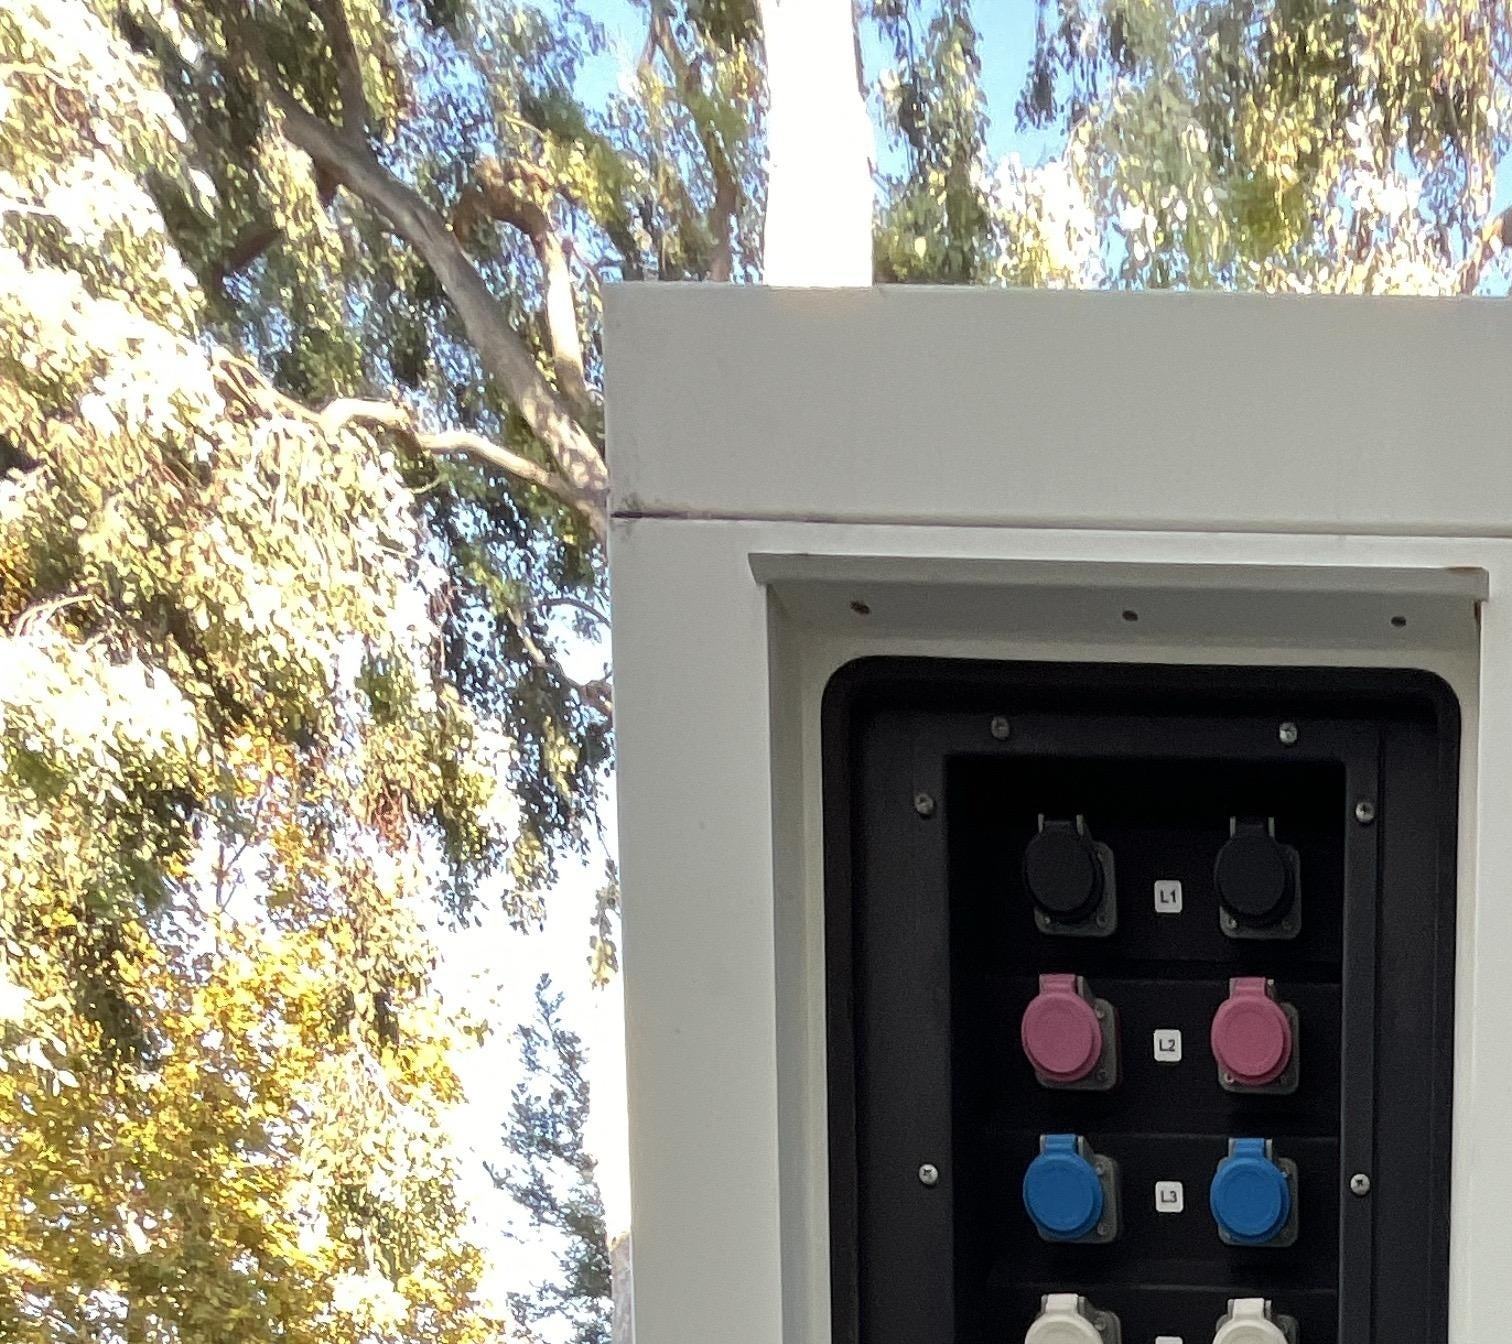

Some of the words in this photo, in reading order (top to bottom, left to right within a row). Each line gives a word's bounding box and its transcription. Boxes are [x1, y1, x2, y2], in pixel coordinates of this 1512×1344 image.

[1160, 889, 1177, 904] L1
[1159, 1038, 1176, 1052] L2
[1160, 1190, 1177, 1203] L3
